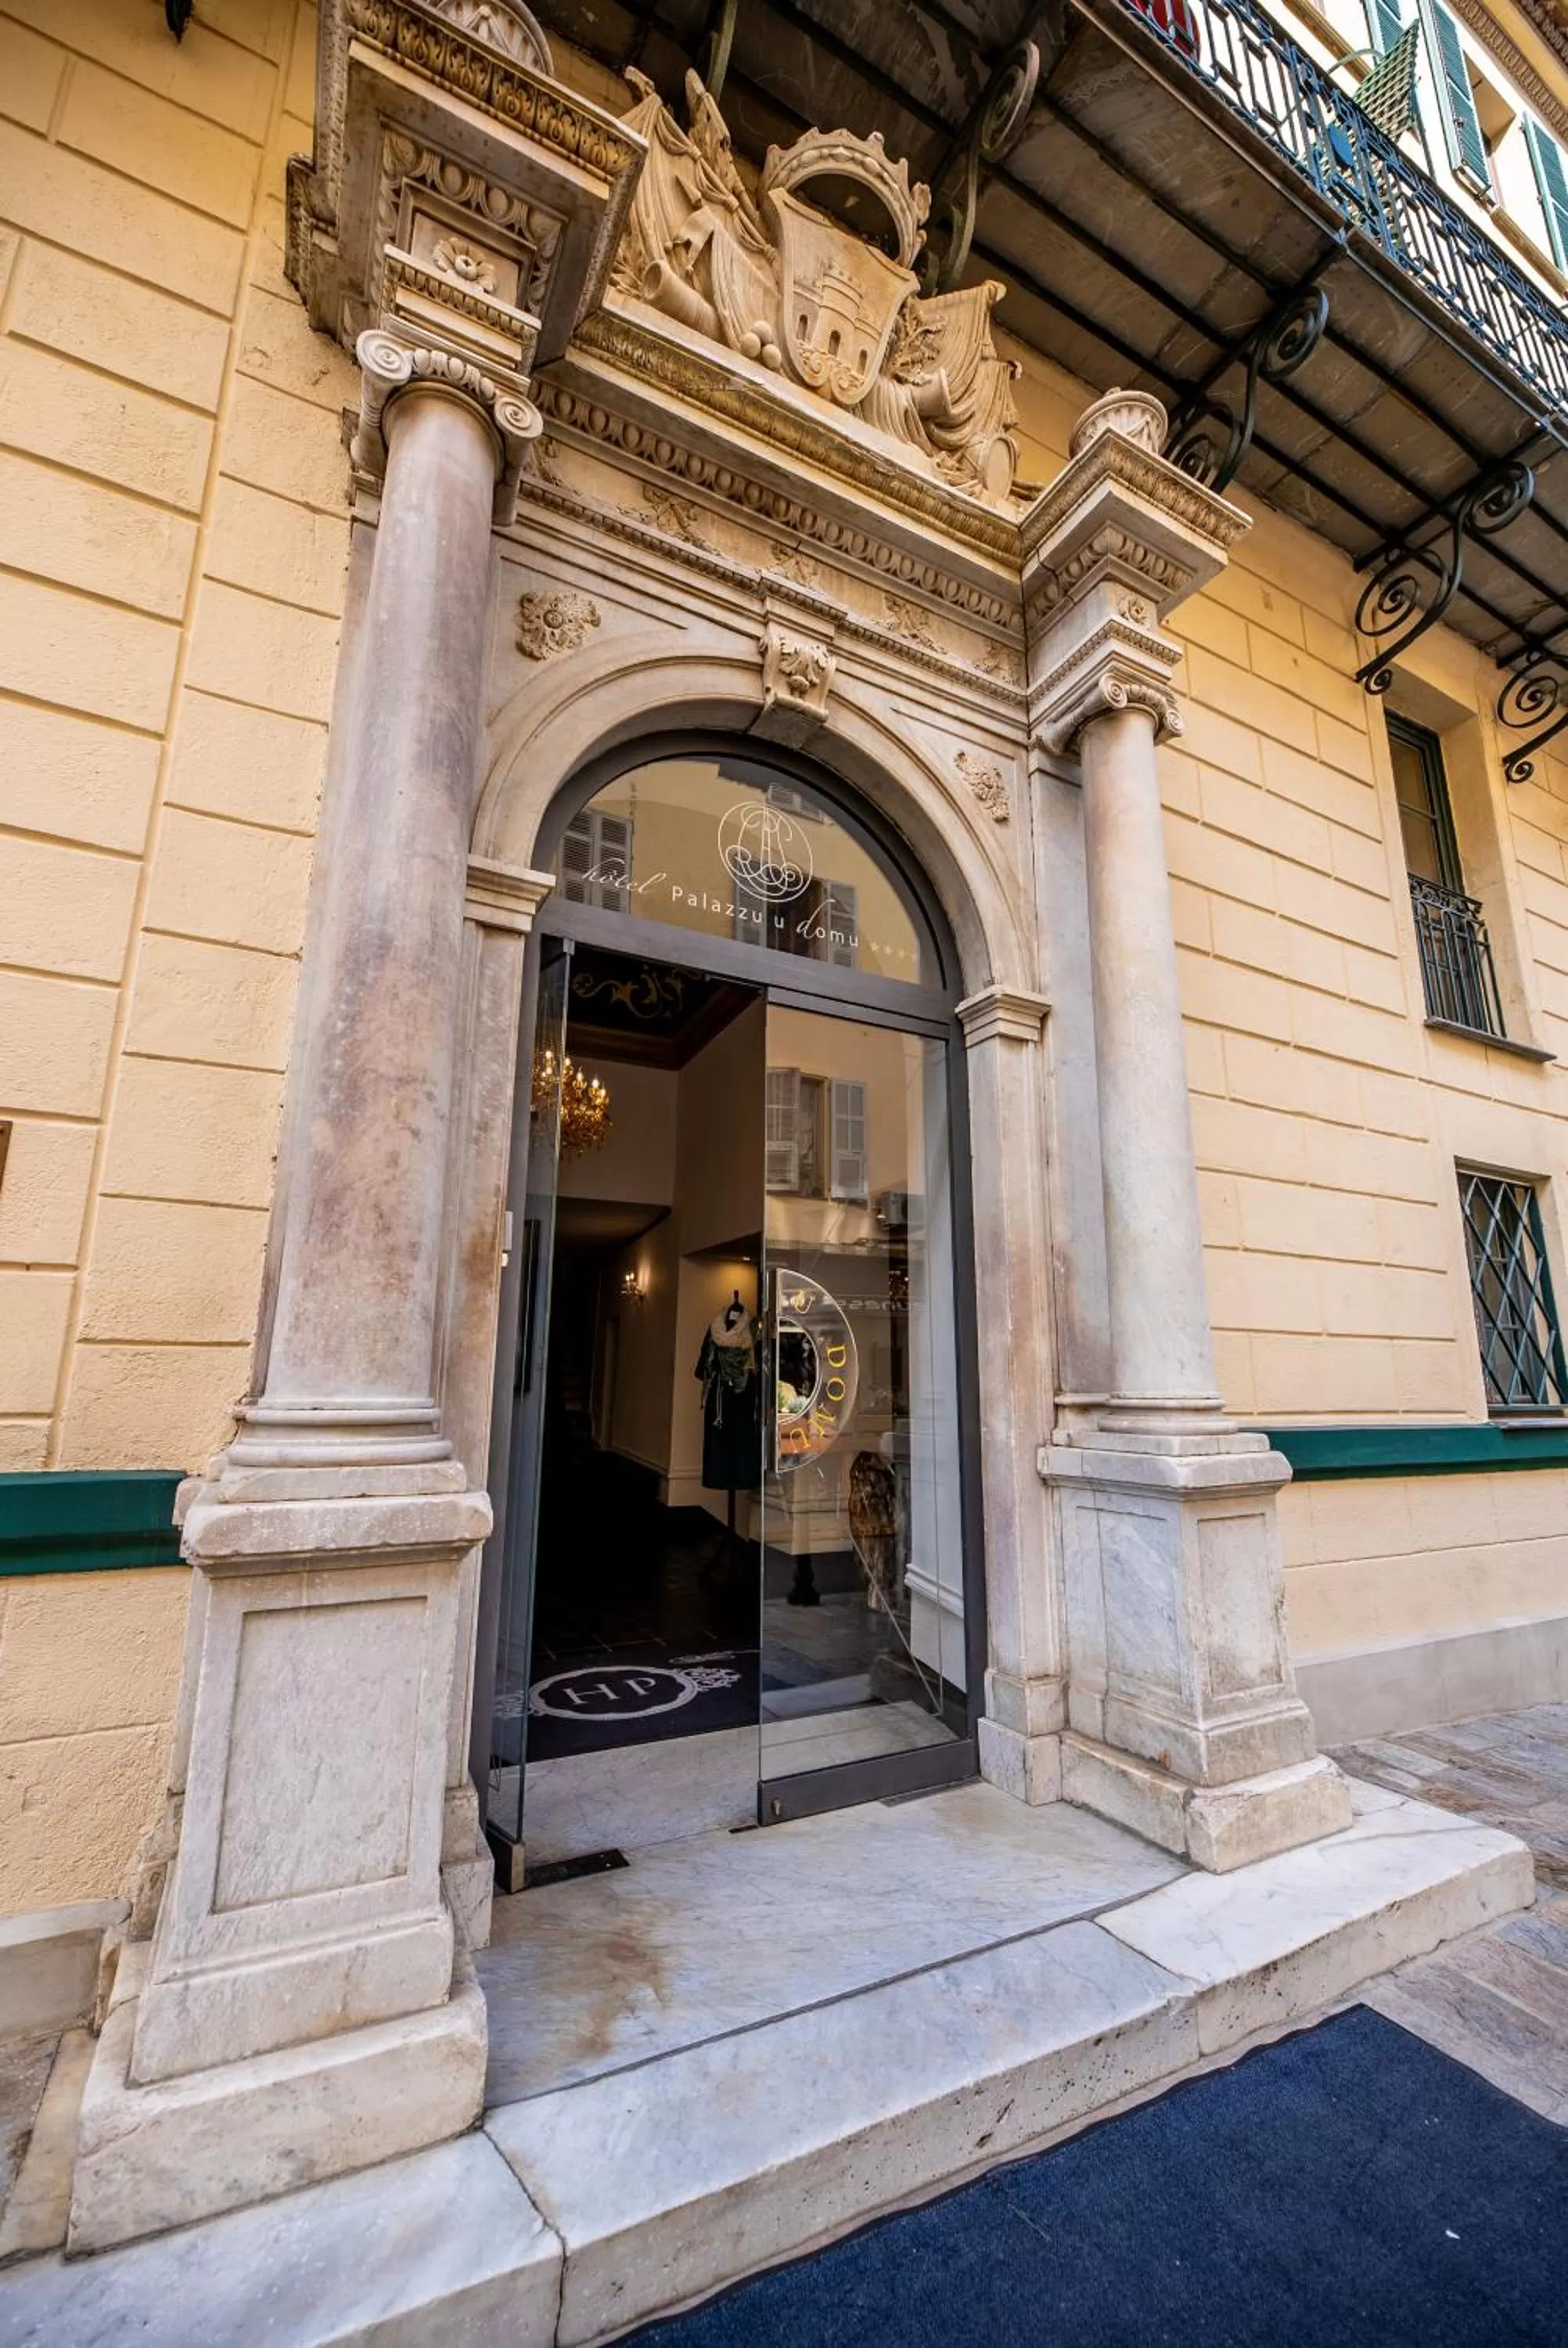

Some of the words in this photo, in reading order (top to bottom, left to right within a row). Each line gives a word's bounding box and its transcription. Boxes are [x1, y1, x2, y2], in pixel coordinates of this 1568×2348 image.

[672, 885, 763, 924] Palazzu
[774, 915, 785, 929] u
[796, 899, 859, 947] domu
